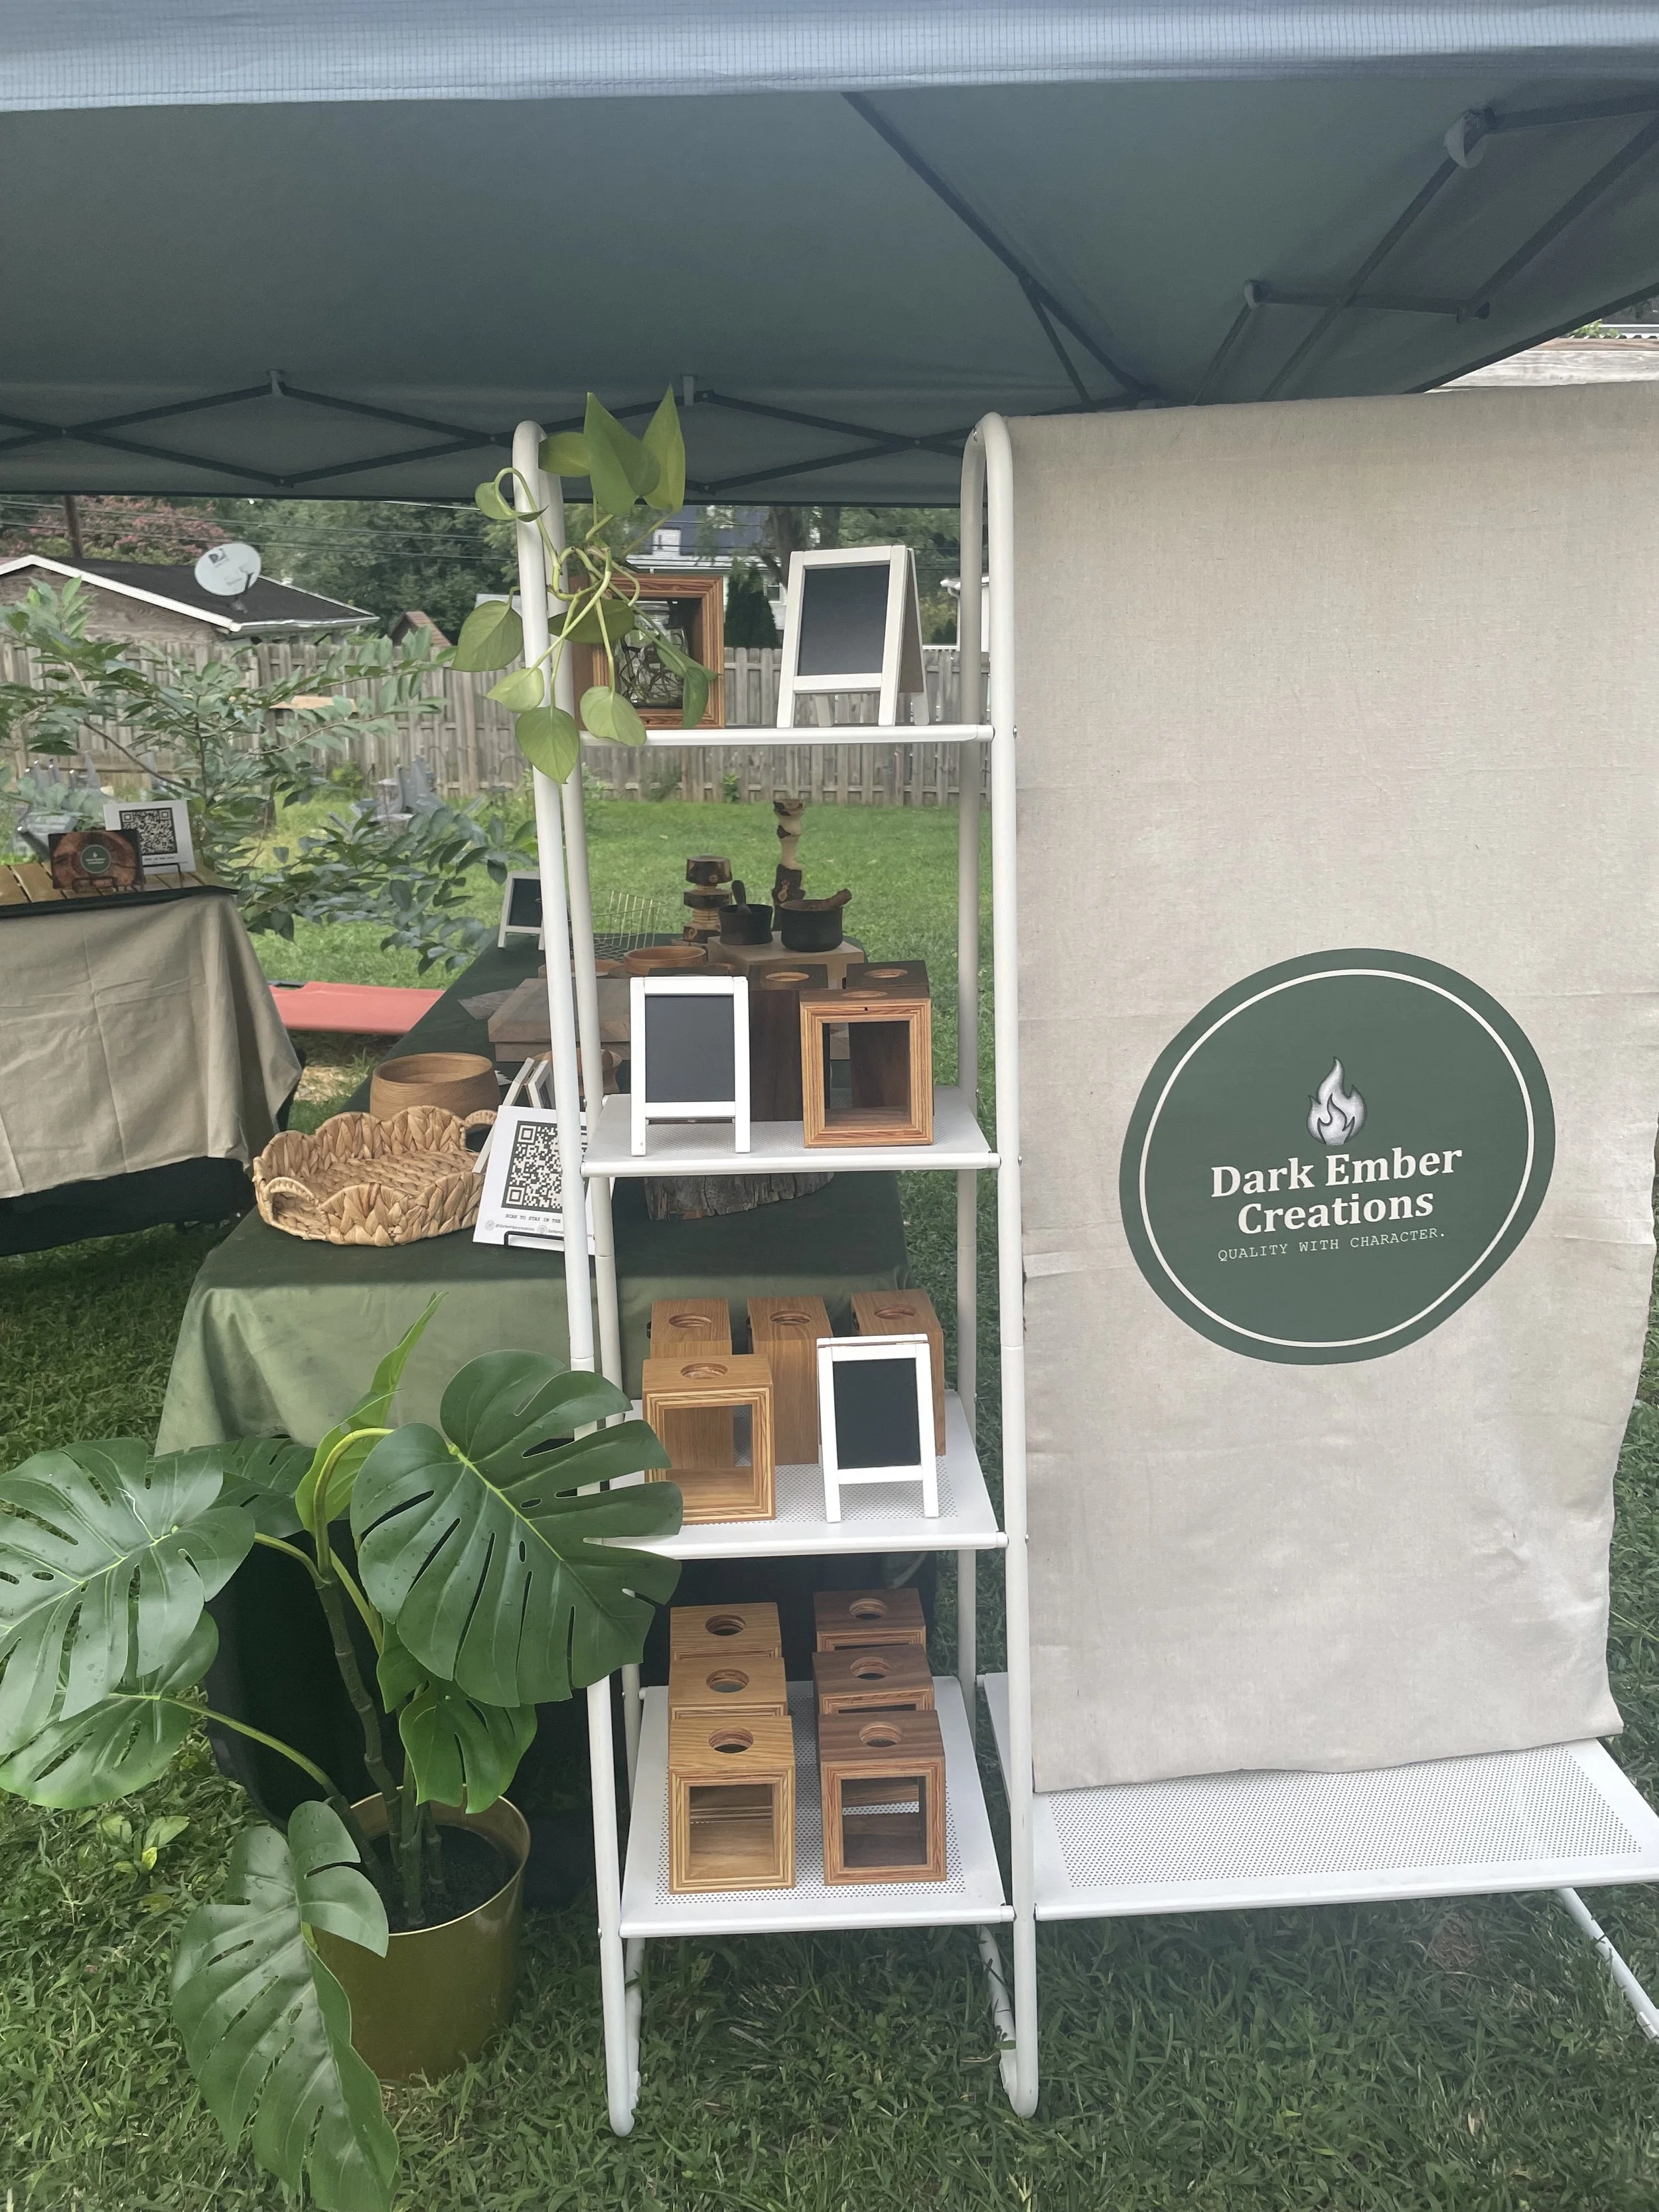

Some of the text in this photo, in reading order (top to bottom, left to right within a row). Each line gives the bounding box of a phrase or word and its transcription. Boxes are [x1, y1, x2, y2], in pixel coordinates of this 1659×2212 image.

[1210, 1147, 1463, 1197] Dark Ember
[1238, 1193, 1433, 1234] Creations
[1218, 1228, 1445, 1262] QUALITY WITH CHARACTER.
